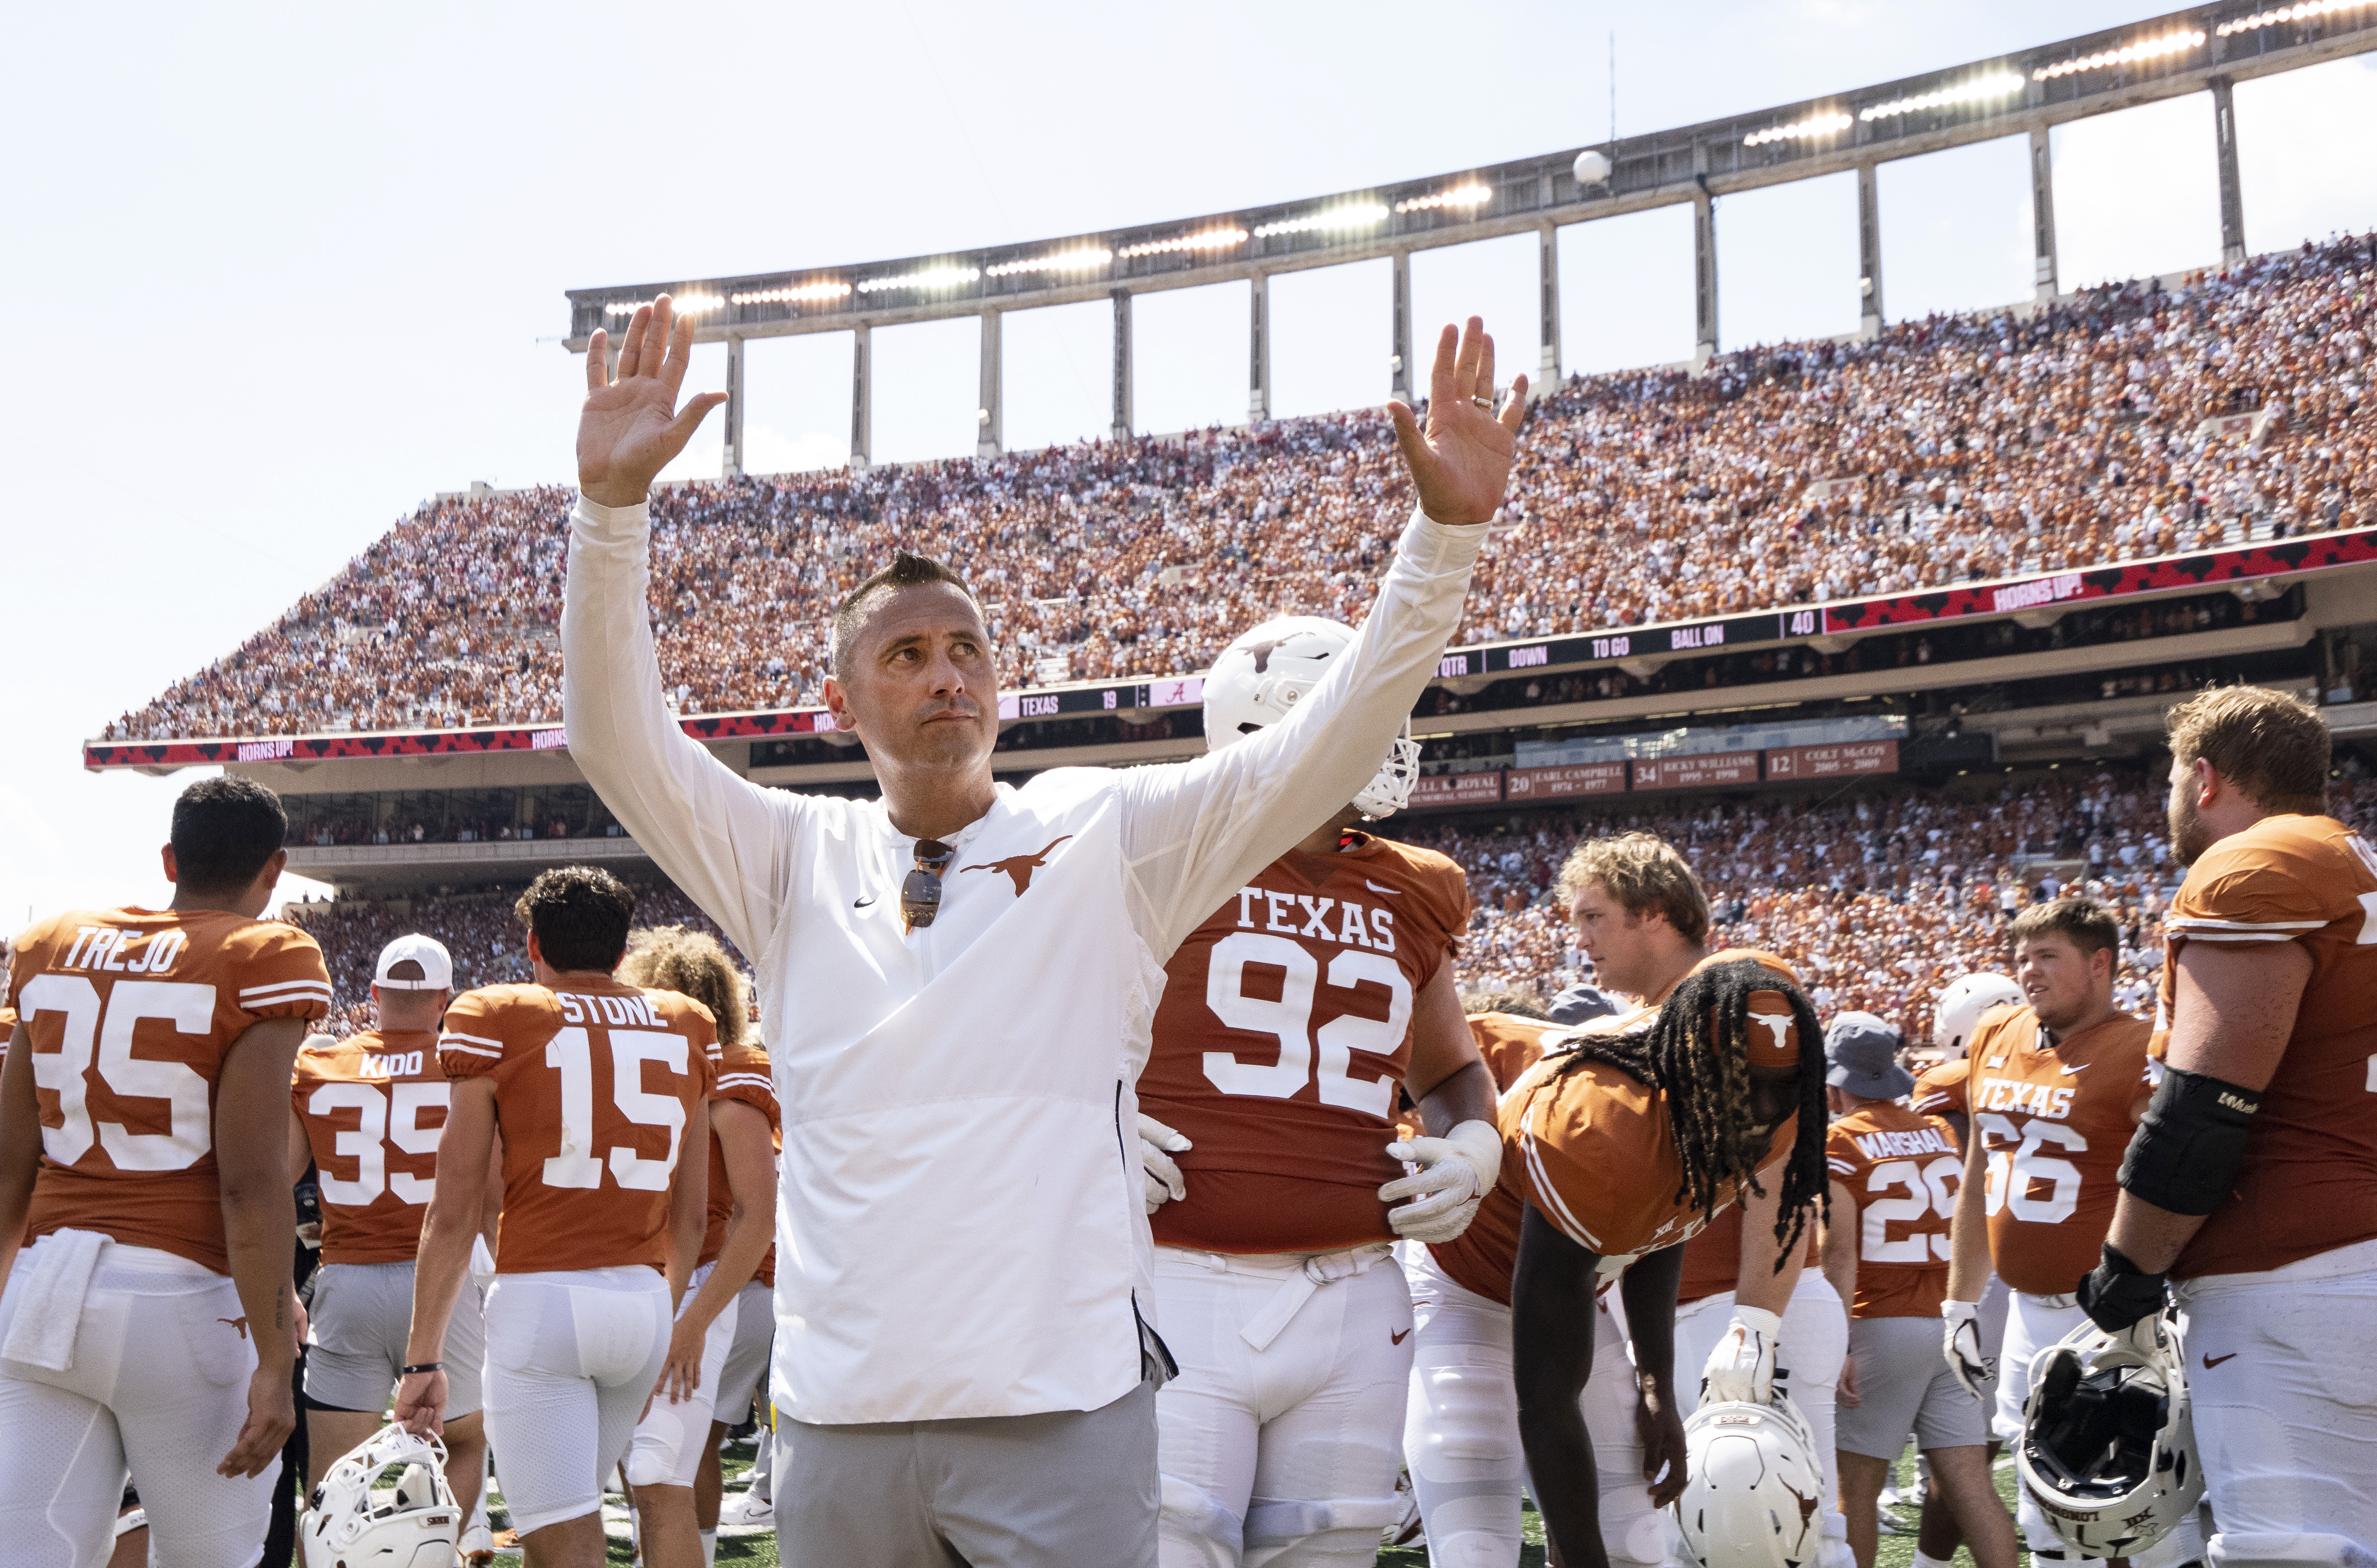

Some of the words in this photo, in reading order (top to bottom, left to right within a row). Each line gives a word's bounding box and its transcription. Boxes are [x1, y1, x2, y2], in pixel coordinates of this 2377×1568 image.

[1993, 579, 2053, 612] HORNS
[2053, 573, 2083, 599] UP!
[1791, 610, 1815, 635] 40
[1592, 639, 1609, 658] TO
[1610, 636, 1630, 656] GO
[1671, 627, 1702, 650] BALL
[1704, 624, 1724, 646] ON
[1440, 655, 1467, 678] QTR
[1508, 645, 1548, 669] DOWN
[1021, 696, 1059, 716] TEXAS
[1102, 690, 1117, 710] 19
[238, 742, 276, 763] HORNS
[276, 740, 293, 758] UP!
[532, 728, 567, 750] HORNS
[1636, 766, 1656, 784] 34
[1772, 756, 1790, 773] 12
[1509, 776, 1530, 793] 20
[1234, 886, 1396, 952] TEXAS
[65, 926, 187, 973] TREJO
[555, 992, 669, 1027] STONE
[1202, 931, 1413, 1119] 92
[359, 1050, 423, 1077] KIDD
[542, 1026, 689, 1192] 15
[1977, 1077, 2076, 1120] TEXAS
[1860, 1155, 1964, 1262] 29
